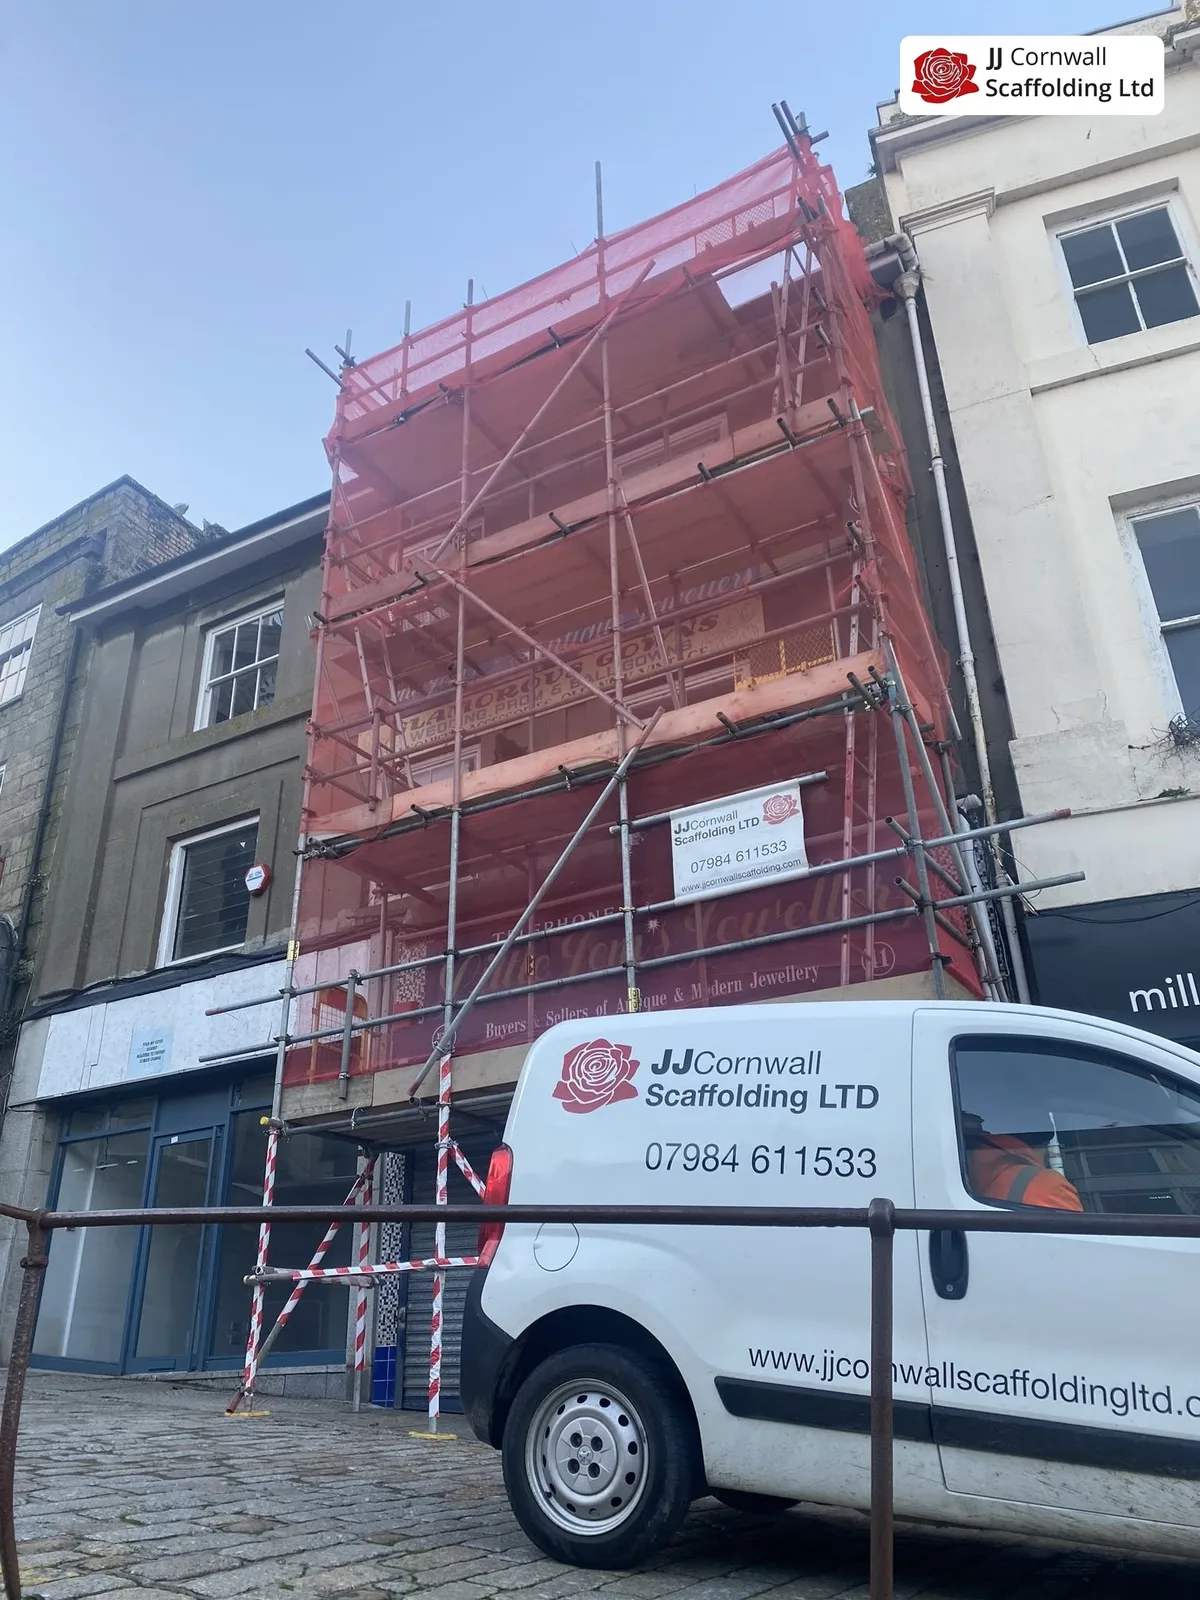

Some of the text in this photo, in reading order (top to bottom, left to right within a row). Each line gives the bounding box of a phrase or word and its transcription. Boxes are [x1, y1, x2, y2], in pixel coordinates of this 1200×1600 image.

[409, 707, 493, 742] WEDDNG,
[674, 816, 760, 847] Scaffolding LTD
[690, 840, 788, 874] 07984 611533
[681, 858, 801, 893] www.jjcornwallscaffolding.com
[486, 1020, 526, 1040] Buyers
[546, 1007, 588, 1027] Sellers
[596, 1000, 608, 1017] of
[616, 993, 667, 1013] Aique
[674, 987, 685, 1003] &
[750, 963, 819, 989] Jewellery
[1129, 972, 1200, 1013] mill
[645, 1083, 880, 1115] Scaffolding LTD
[645, 1142, 877, 1179] 07984 611533
[748, 1346, 1200, 1418] www.jjconwallscaffoldingltd.c
